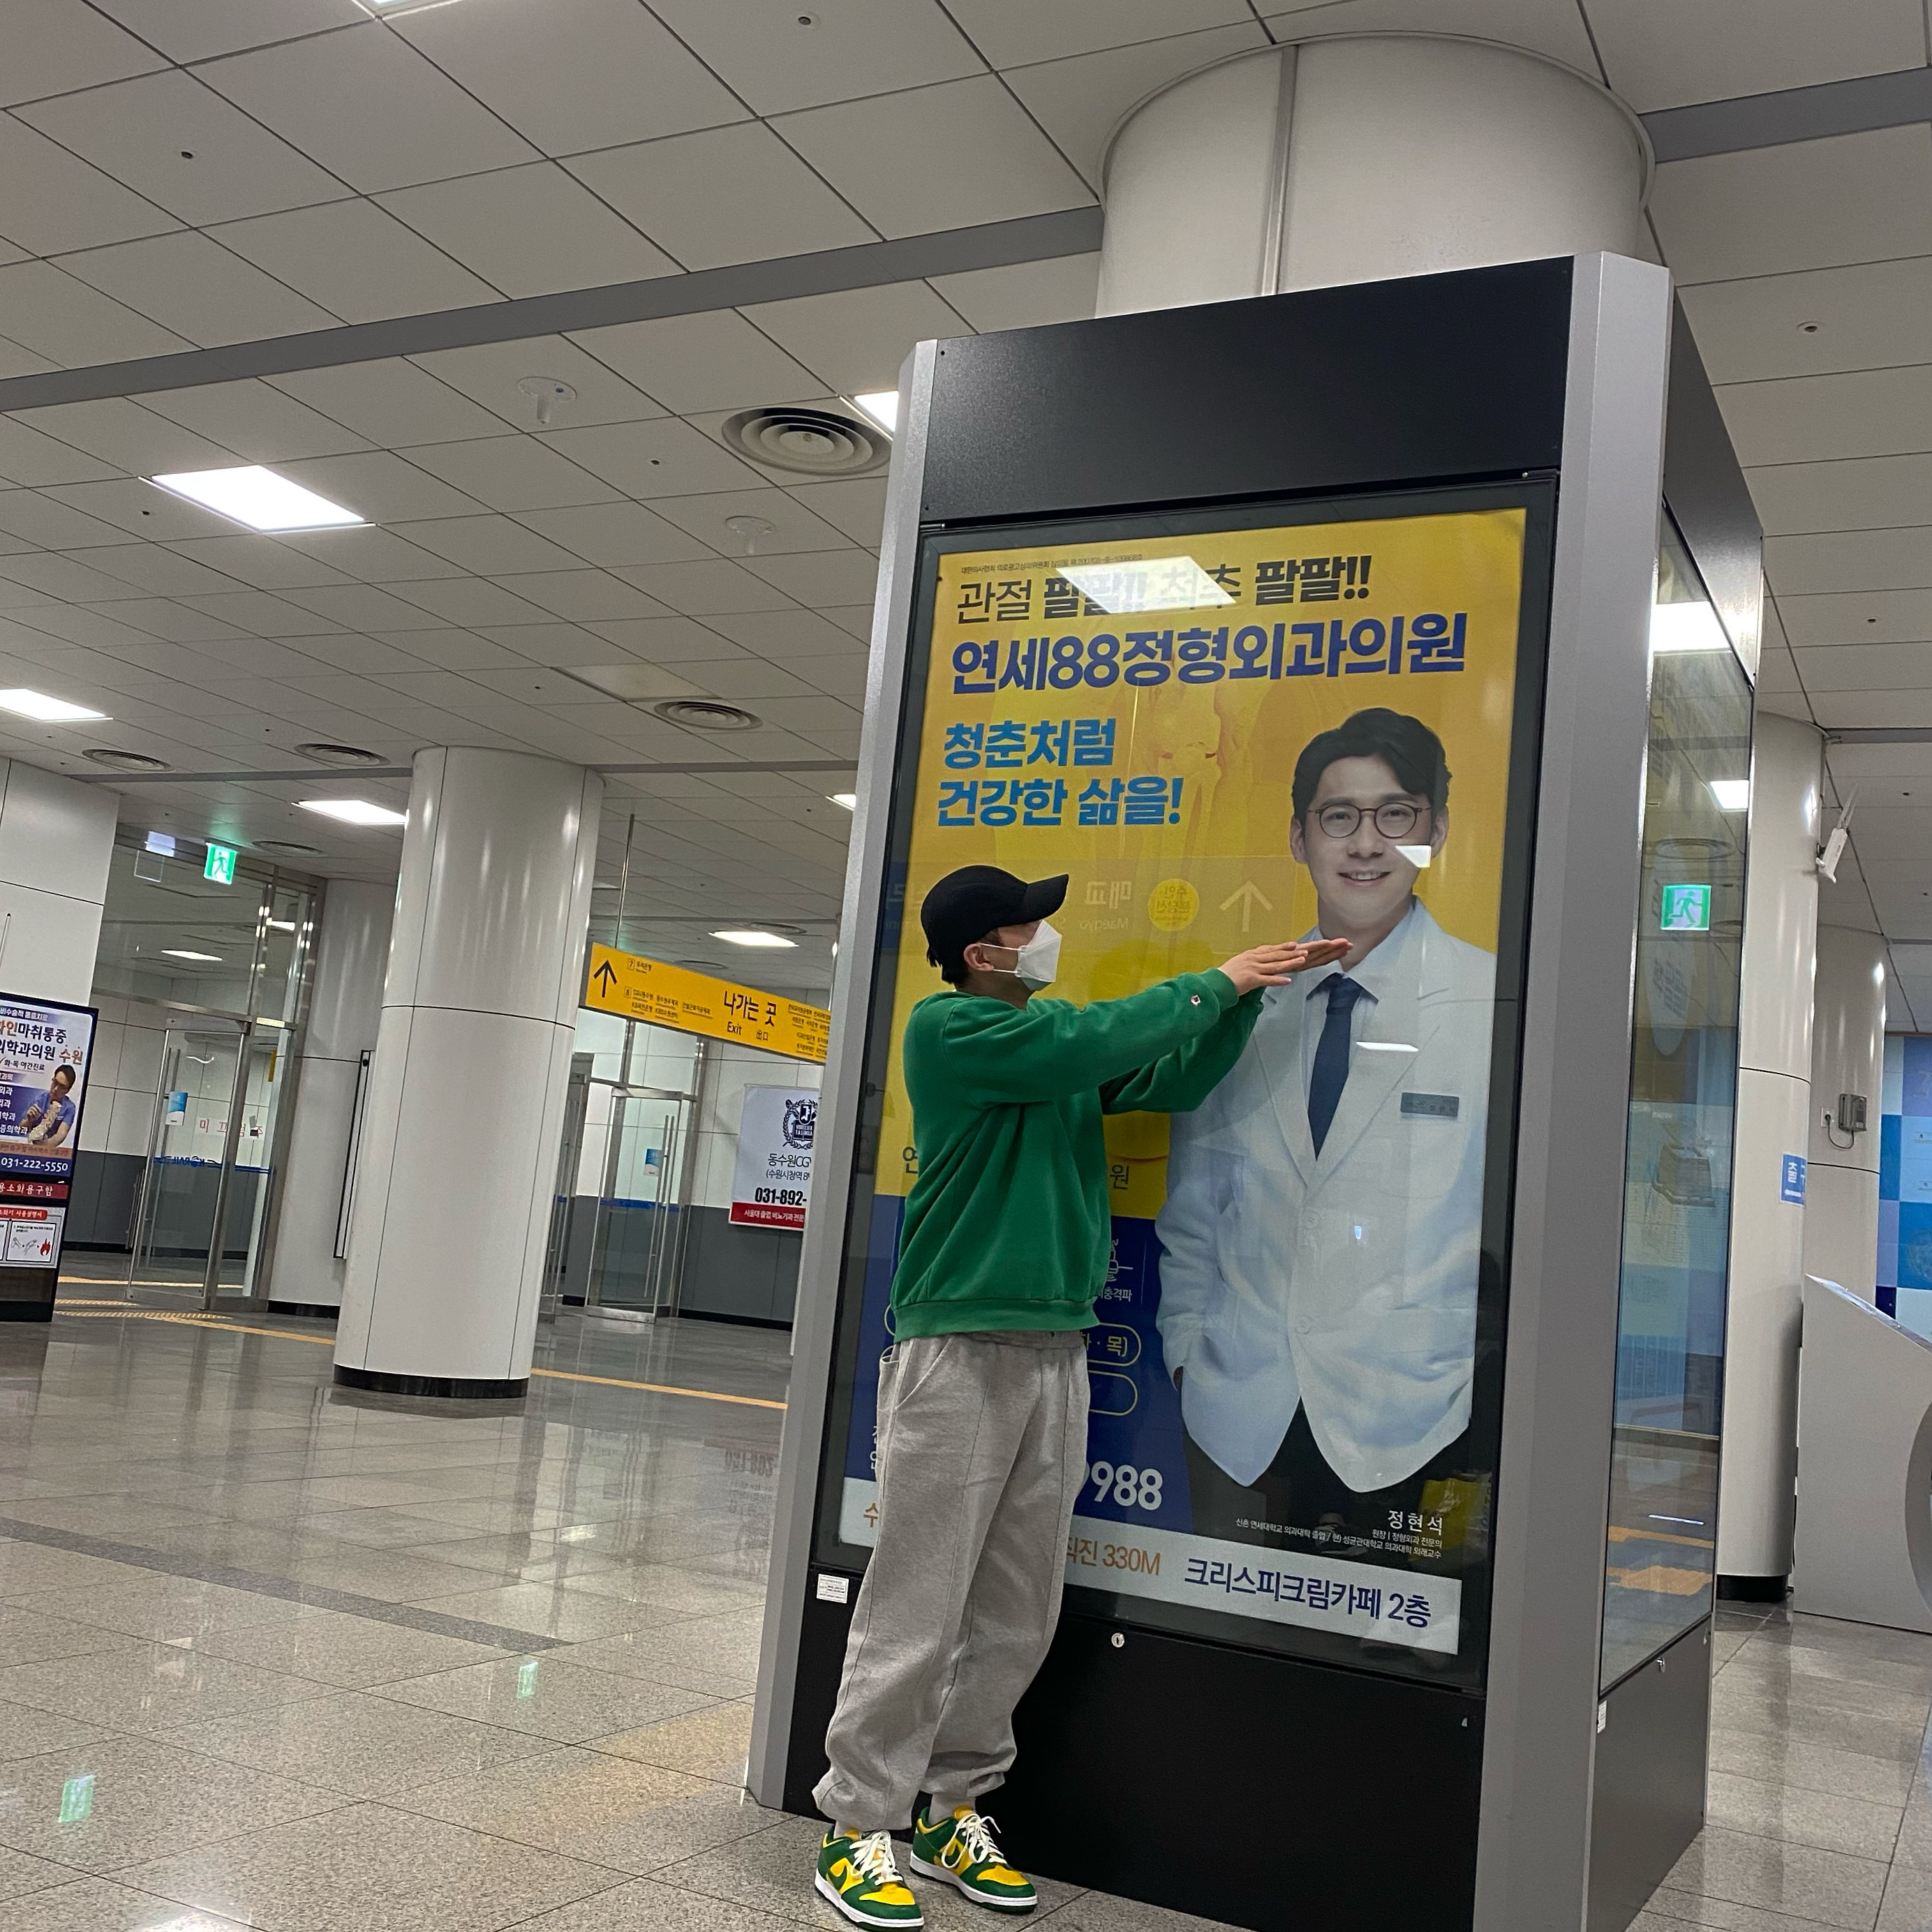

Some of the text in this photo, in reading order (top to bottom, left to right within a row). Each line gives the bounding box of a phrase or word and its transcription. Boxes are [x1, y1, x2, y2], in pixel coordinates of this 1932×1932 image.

[957, 579, 1032, 625] 관절
[1254, 555, 1372, 606] 팔팔!!
[951, 611, 1468, 695] 연세88정형외과의원
[943, 717, 1117, 770] 청춘처럼
[937, 775, 1184, 827] 건강한 삶을!
[723, 990, 778, 1027] 나가는 곳
[727, 1020, 742, 1035] Exit
[756, 1029, 769, 1041] 出口
[59, 1048, 84, 1065] 수원
[0, 1110, 16, 1122] 학과
[1, 1157, 68, 1173] 031-222-5550
[766, 1169, 803, 1182] (수원시청역
[755, 1187, 807, 1206] 031-892-
[794, 1213, 804, 1222] 전문
[1100, 1286, 1133, 1302] 충격파
[1083, 1460, 1164, 1511] 988
[1250, 1520, 1283, 1533] 연세대학교
[1284, 1526, 1311, 1538] 의과대학
[1342, 1535, 1383, 1550] 성균관대학교
[1384, 1540, 1413, 1554] 의과대학
[1413, 1545, 1443, 1559] 외래교수
[1372, 1529, 1387, 1540] 원장
[1391, 1531, 1420, 1545] 정형외과
[1420, 1536, 1443, 1548] 전문의
[1102, 1543, 1161, 1576] 330M
[1184, 1557, 1432, 1628] 크리스피크림카페 2층
